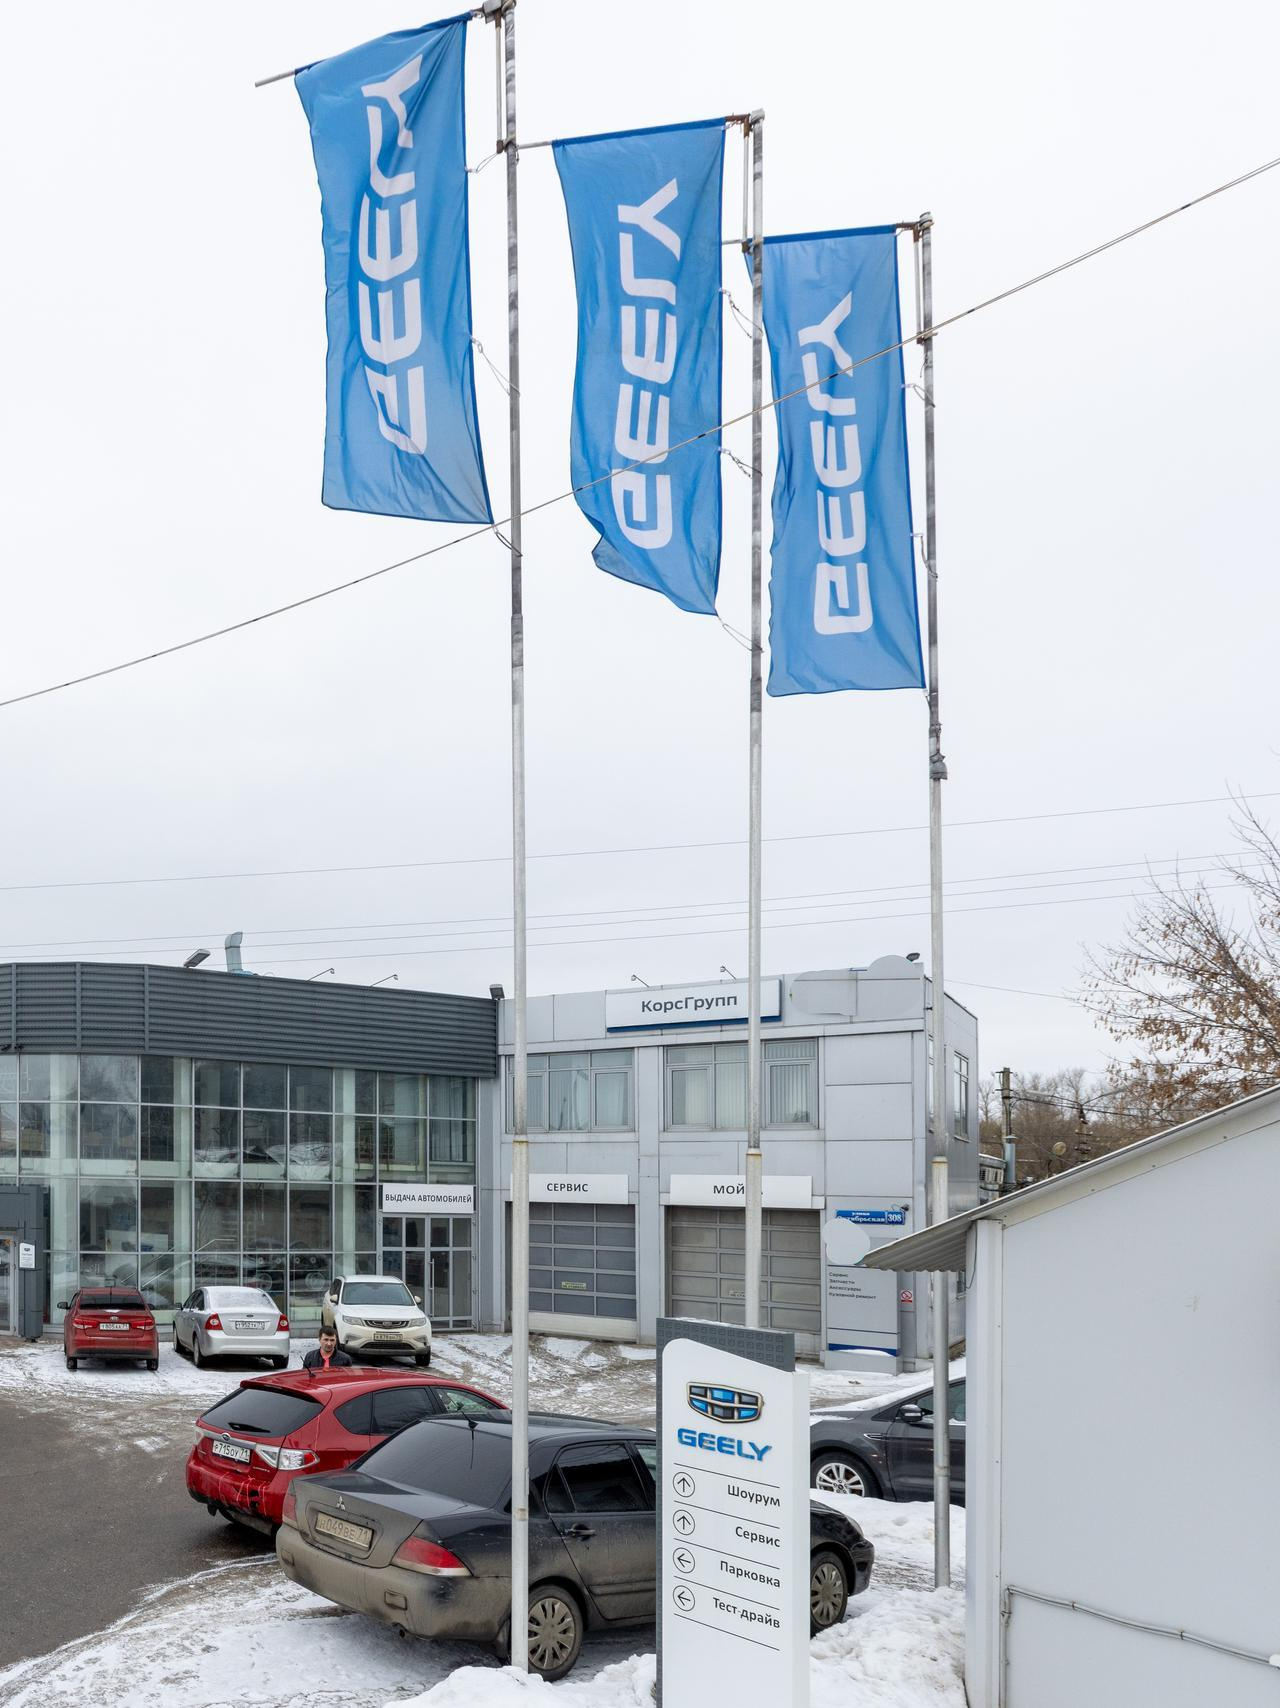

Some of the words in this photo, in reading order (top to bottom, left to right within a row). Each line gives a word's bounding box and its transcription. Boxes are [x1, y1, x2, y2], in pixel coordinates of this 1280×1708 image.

[642, 995, 737, 1013] КорсГрупп
[546, 1183, 589, 1192] СЕРВИС
[713, 1183, 763, 1195] МОЙ
[385, 1194, 416, 1203] ВЫДАЧА
[418, 1194, 472, 1203] АВТОМОБИЛЕЙ
[888, 1214, 902, 1222] 308
[677, 1428, 772, 1462] GEELY
[727, 1484, 780, 1508] Шоурум
[735, 1526, 780, 1548] Сервис
[720, 1560, 780, 1588] Парковка
[713, 1597, 780, 1629] Тест-драйв
